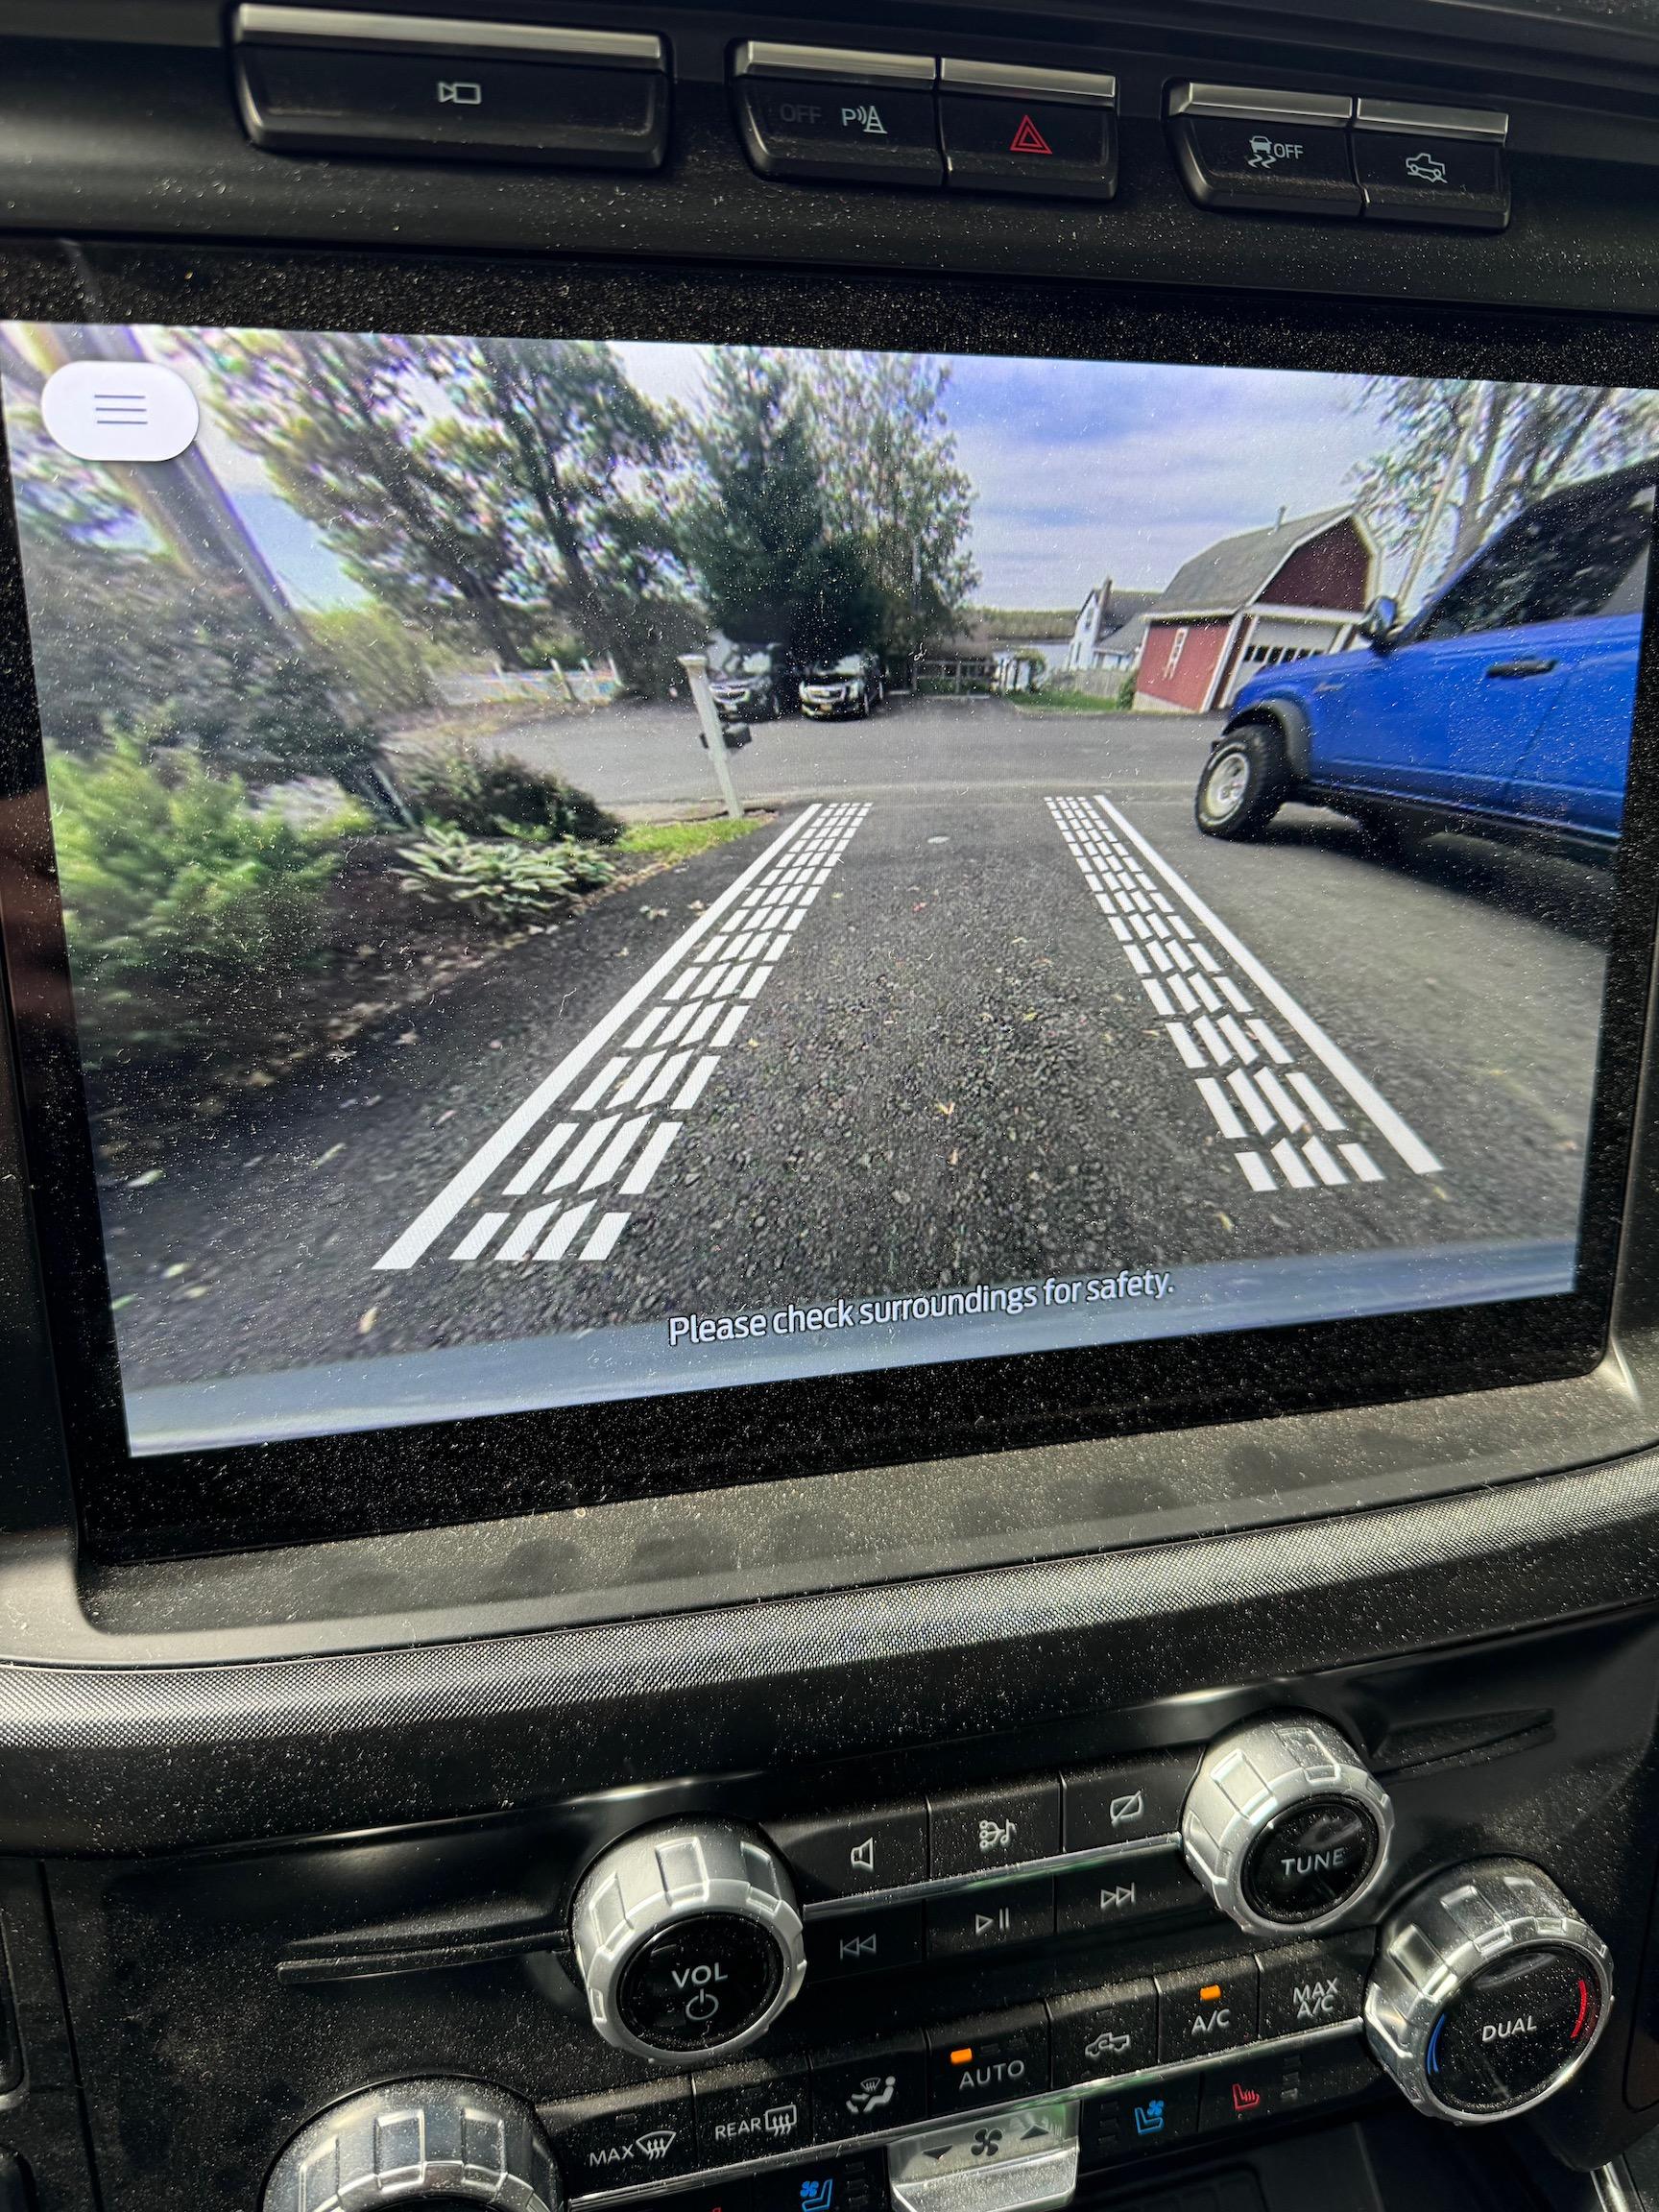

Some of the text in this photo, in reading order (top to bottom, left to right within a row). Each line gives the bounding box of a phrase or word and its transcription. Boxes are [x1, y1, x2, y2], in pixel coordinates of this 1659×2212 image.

[1273, 143, 1304, 159] OFF
[669, 1269, 1174, 1346] Please check surroundings for safety.
[1281, 1847, 1345, 1876] TUNE
[671, 1961, 729, 1989] VOL
[1293, 1977, 1339, 2005] MAX
[1297, 1994, 1335, 2019] A/C
[1191, 2008, 1232, 2035] A/C
[1481, 2015, 1537, 2042] DUAL
[959, 2059, 1025, 2090] AUTO
[714, 2117, 762, 2141] REAR
[589, 2144, 635, 2168] MAX
